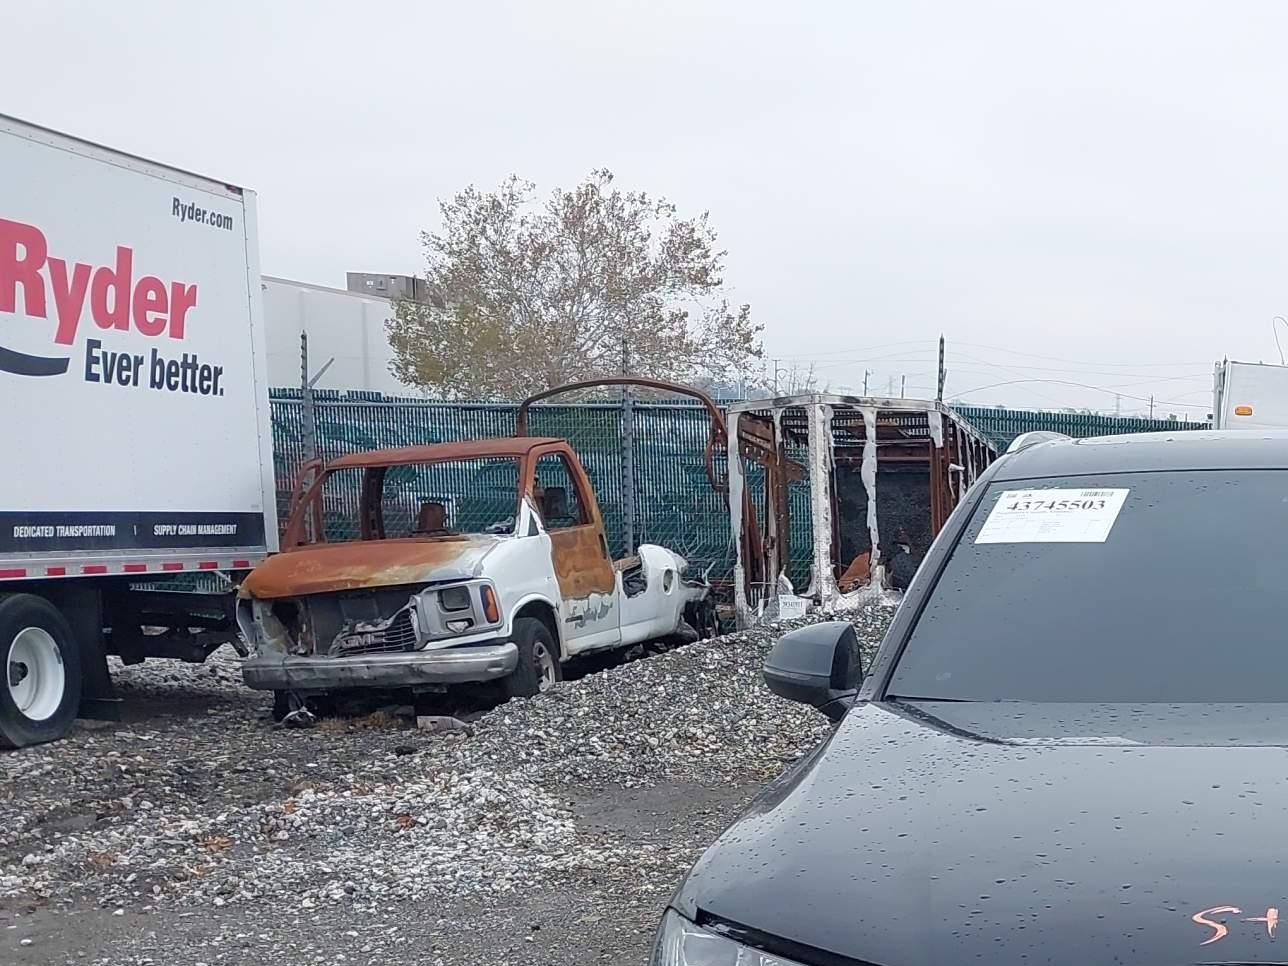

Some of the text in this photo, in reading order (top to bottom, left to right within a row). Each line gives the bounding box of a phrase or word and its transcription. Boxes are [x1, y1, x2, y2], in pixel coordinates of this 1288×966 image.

[173, 197, 233, 231] Ryder.com
[0, 218, 197, 346] Ryder
[85, 339, 224, 396] Ever better.
[1006, 499, 1106, 511] 43745503
[13, 525, 116, 538] DEDICATED TRANSPORTATION
[153, 524, 237, 536] SUPPLY CHAIN MANAGEMENT
[341, 631, 385, 649] GMC
